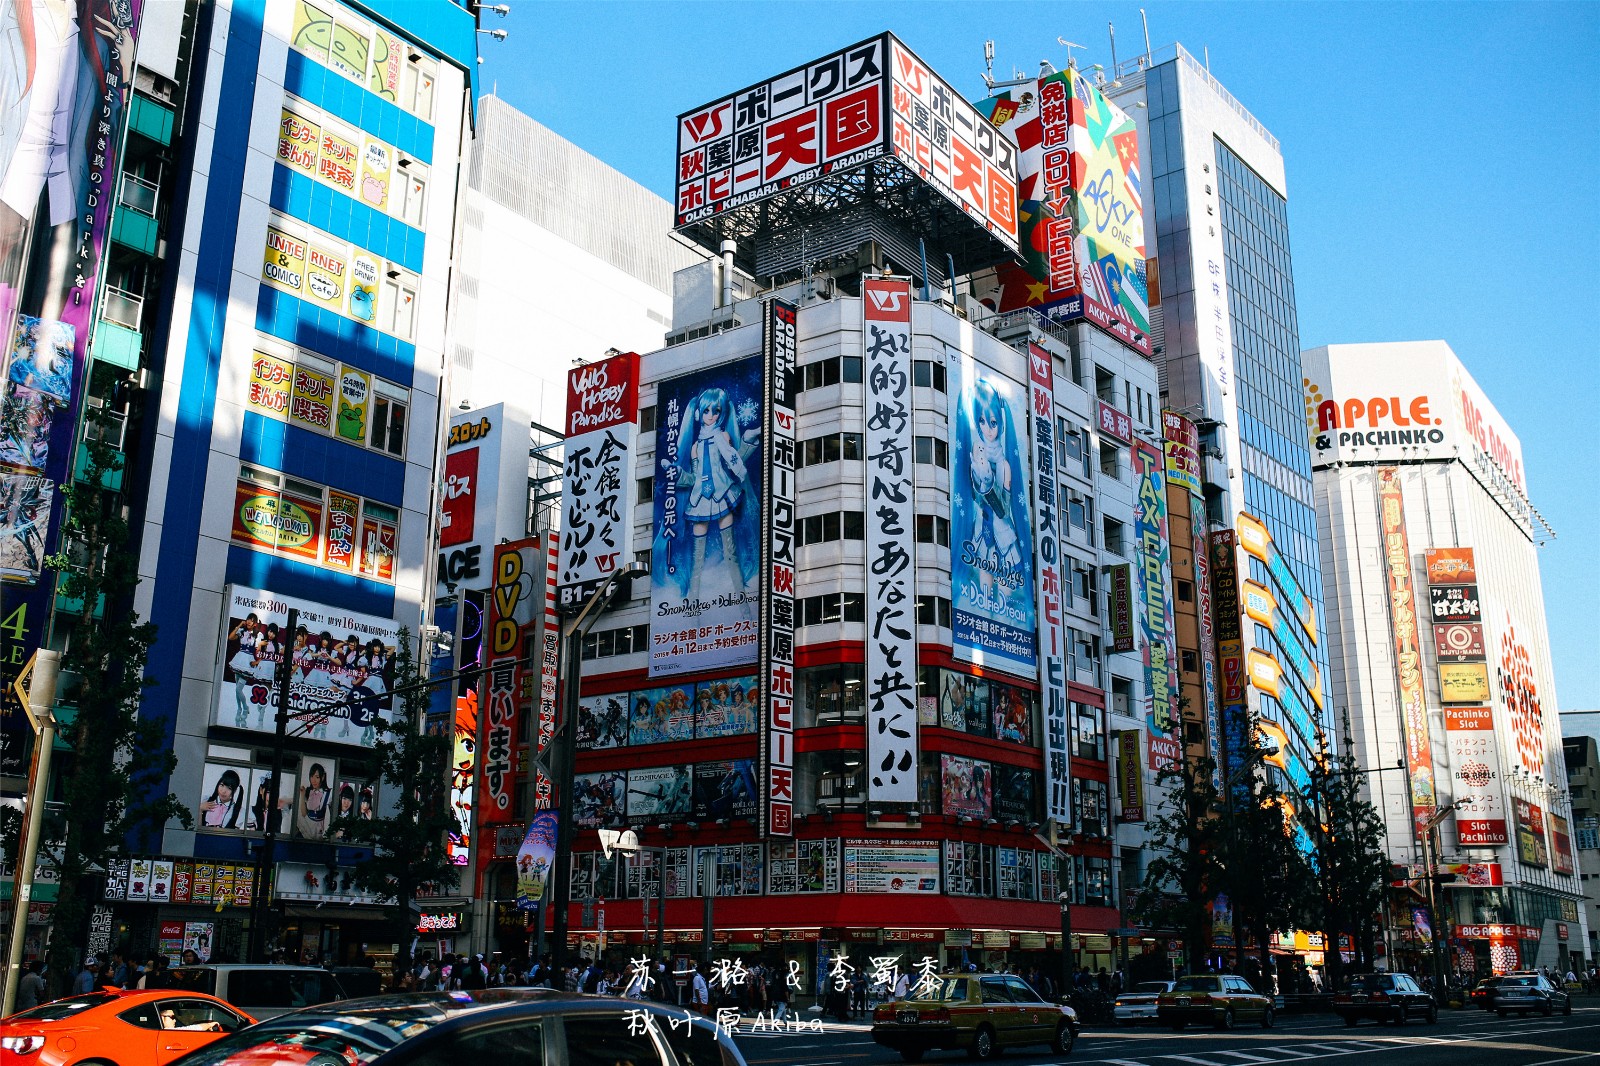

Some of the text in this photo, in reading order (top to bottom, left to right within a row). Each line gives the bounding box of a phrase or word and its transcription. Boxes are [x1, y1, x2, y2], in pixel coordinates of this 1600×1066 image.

[737, 44, 881, 128] ボークス
[893, 83, 948, 151] 秋葉原
[1041, 82, 1067, 148] 免税店
[282, 118, 356, 163] インター ネット
[766, 84, 879, 180] 天国
[932, 85, 1014, 178] ボークス
[681, 131, 760, 180] 秋葉原
[894, 121, 949, 176] ホビー
[279, 139, 354, 189] まんが 喫茶
[679, 145, 884, 224] VOLKS AKIHABARA HOBBY PARADISE
[680, 169, 759, 211] ホビー
[952, 136, 1016, 235] 天国
[1083, 178, 1135, 227] AKKY
[1044, 149, 1075, 292] DUTY FREE
[1112, 226, 1132, 248] ONE
[268, 232, 344, 276] INTE RNET
[279, 254, 289, 268] &
[356, 260, 375, 274] FREE
[265, 262, 300, 289] COMICS
[311, 283, 332, 296] cafe
[354, 268, 376, 282] DRINK!
[1089, 304, 1110, 324] AKKY
[774, 305, 786, 402] PARADISE
[785, 306, 796, 375] HOBBY
[253, 357, 332, 399] インター ネット
[343, 376, 366, 391] 24時間
[250, 383, 330, 426] まんが 喫茶
[343, 385, 365, 401] 営業中!
[1103, 408, 1129, 440] 免税
[1462, 390, 1486, 452] BIG
[1316, 429, 1443, 450] & PACHINKO
[594, 430, 628, 548] 全館丸々
[1168, 469, 1187, 480] MEDIA
[245, 507, 310, 536] WELCOME
[1138, 449, 1165, 633] TAX FREE
[1219, 579, 1233, 588] CD
[494, 550, 523, 653] DVD
[1218, 599, 1236, 608] アニメ
[1, 602, 30, 641] 4
[654, 629, 697, 645] ラジオ会館
[699, 627, 713, 638] 8F
[956, 612, 989, 632] ラジオ会館
[990, 623, 1000, 635] 8F
[1115, 637, 1132, 645] AKKY
[1224, 657, 1241, 701] DVD
[361, 709, 374, 722] 2F
[1447, 710, 1489, 719] Pachinko
[1460, 720, 1478, 728] Slot
[1152, 740, 1176, 757] AKKY
[1156, 756, 1175, 769] ONE
[1460, 833, 1505, 841] Pachinko
[1471, 821, 1490, 830] Slot
[771, 842, 797, 859] 3F
[1001, 850, 1016, 866] 5F
[771, 861, 797, 875] 食玩
[827, 859, 838, 891] 中古
[1463, 927, 1480, 935] BIG
